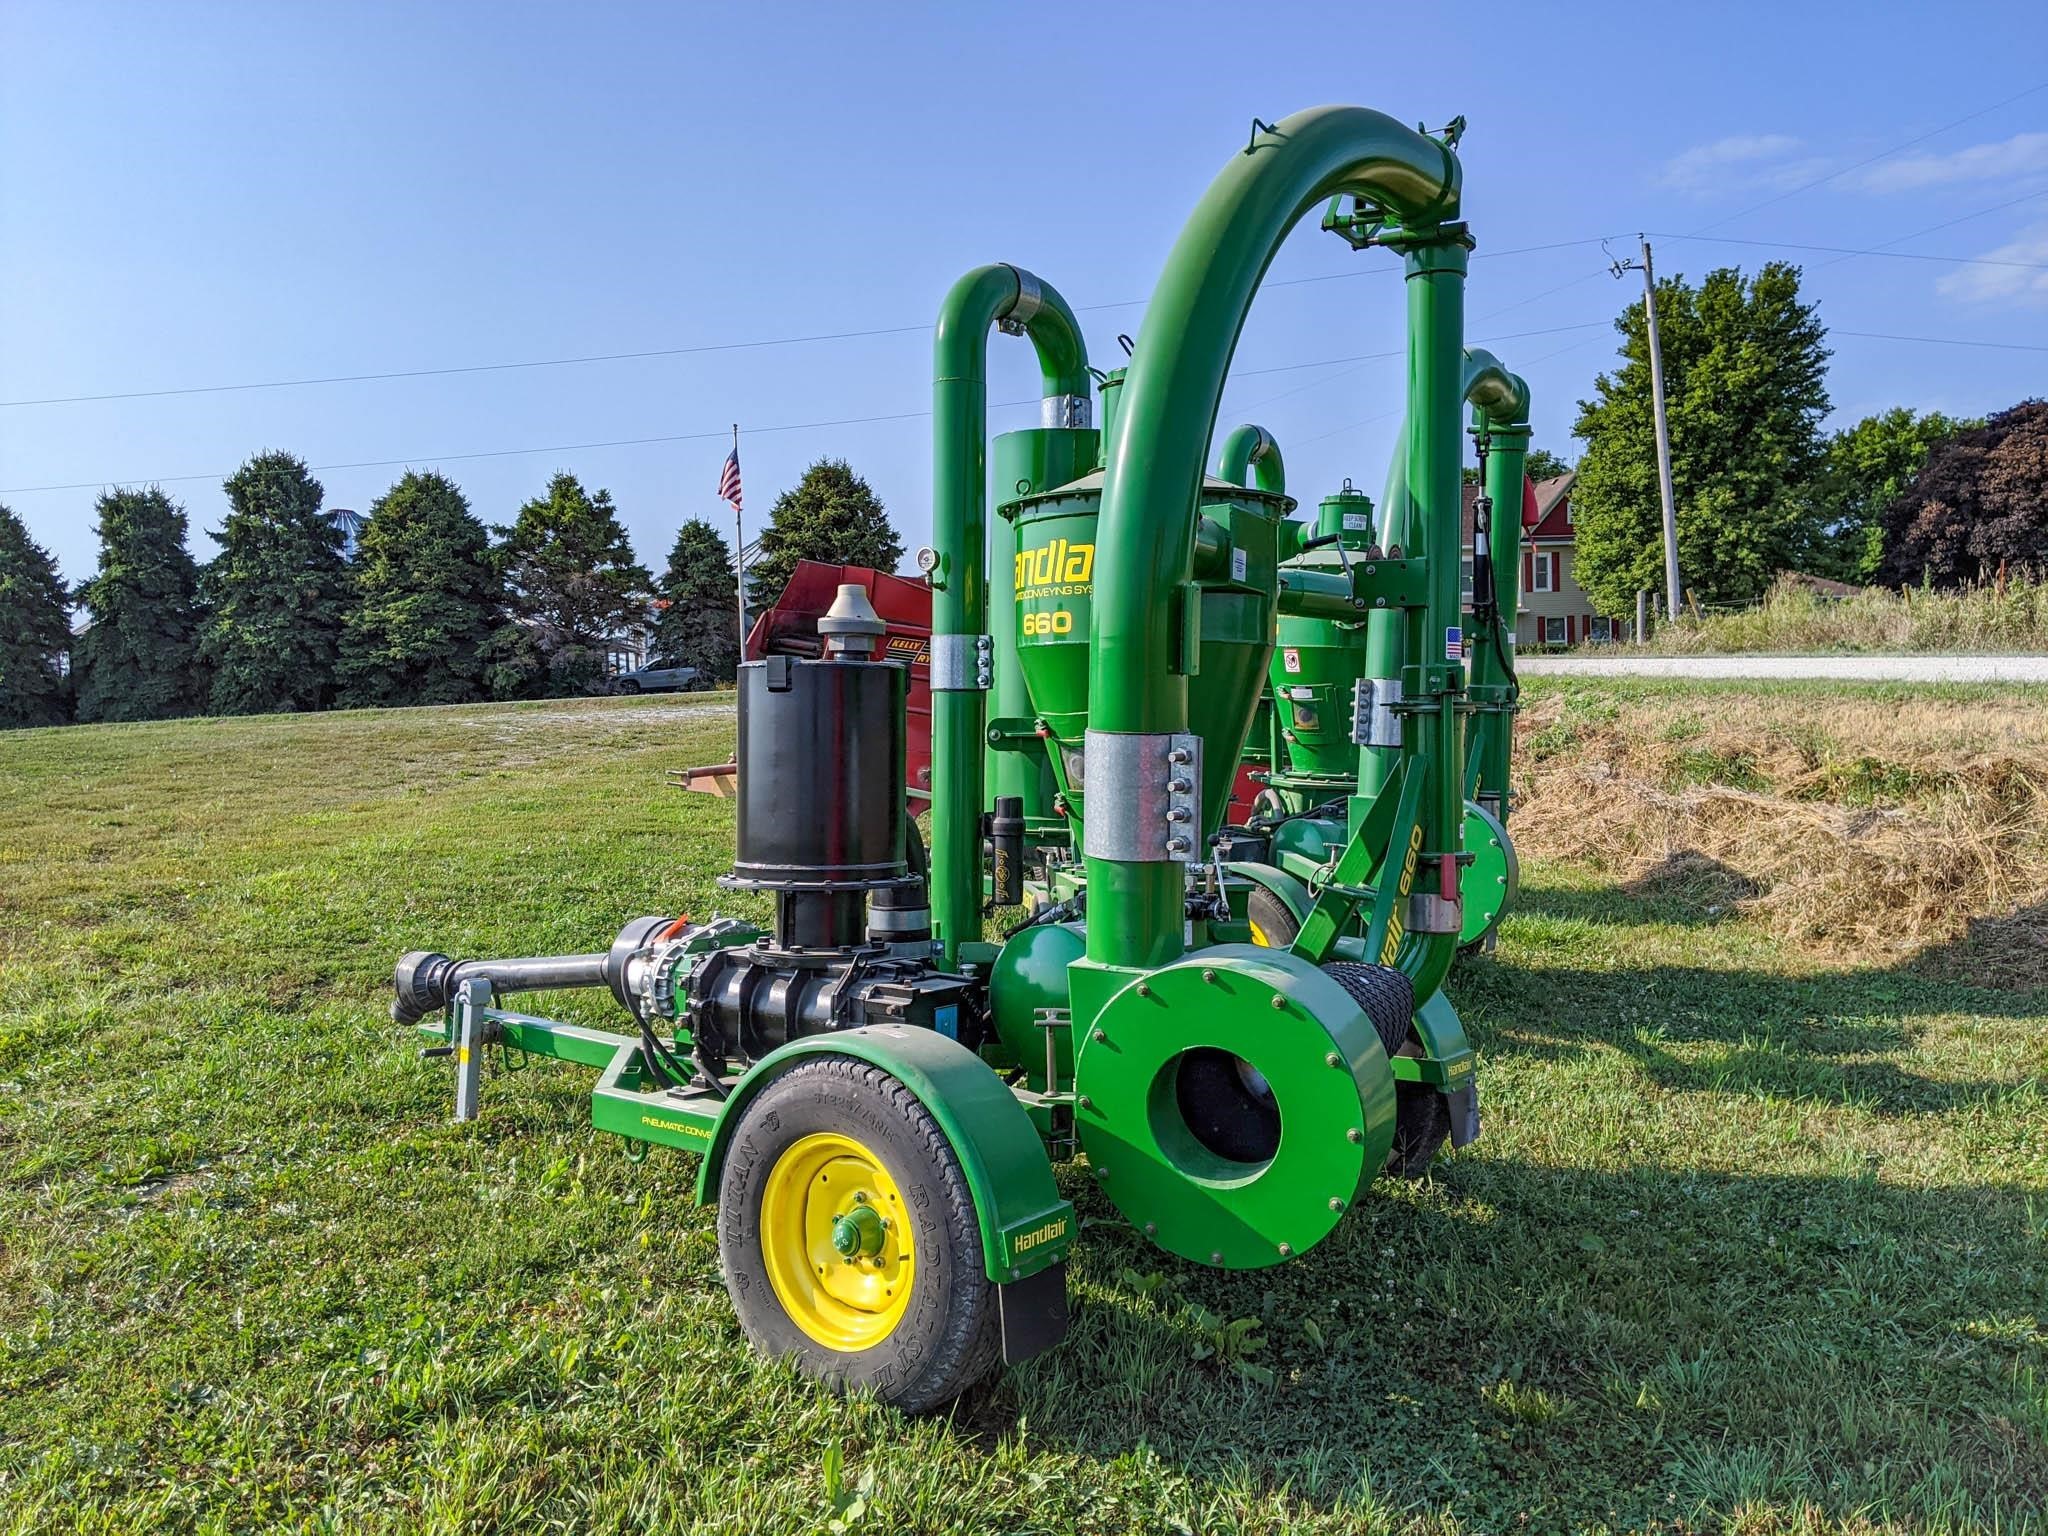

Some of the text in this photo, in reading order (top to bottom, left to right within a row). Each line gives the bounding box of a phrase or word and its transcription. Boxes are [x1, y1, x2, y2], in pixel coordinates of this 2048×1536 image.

[1023, 610, 1072, 635] 660
[891, 639, 922, 650] KELLY
[1399, 823, 1423, 896] 660
[642, 1116, 685, 1133] PNEUMATIC
[725, 1134, 758, 1248] TITAN
[1014, 1216, 1068, 1254] Handlair
[908, 1183, 941, 1335] RADIAL
